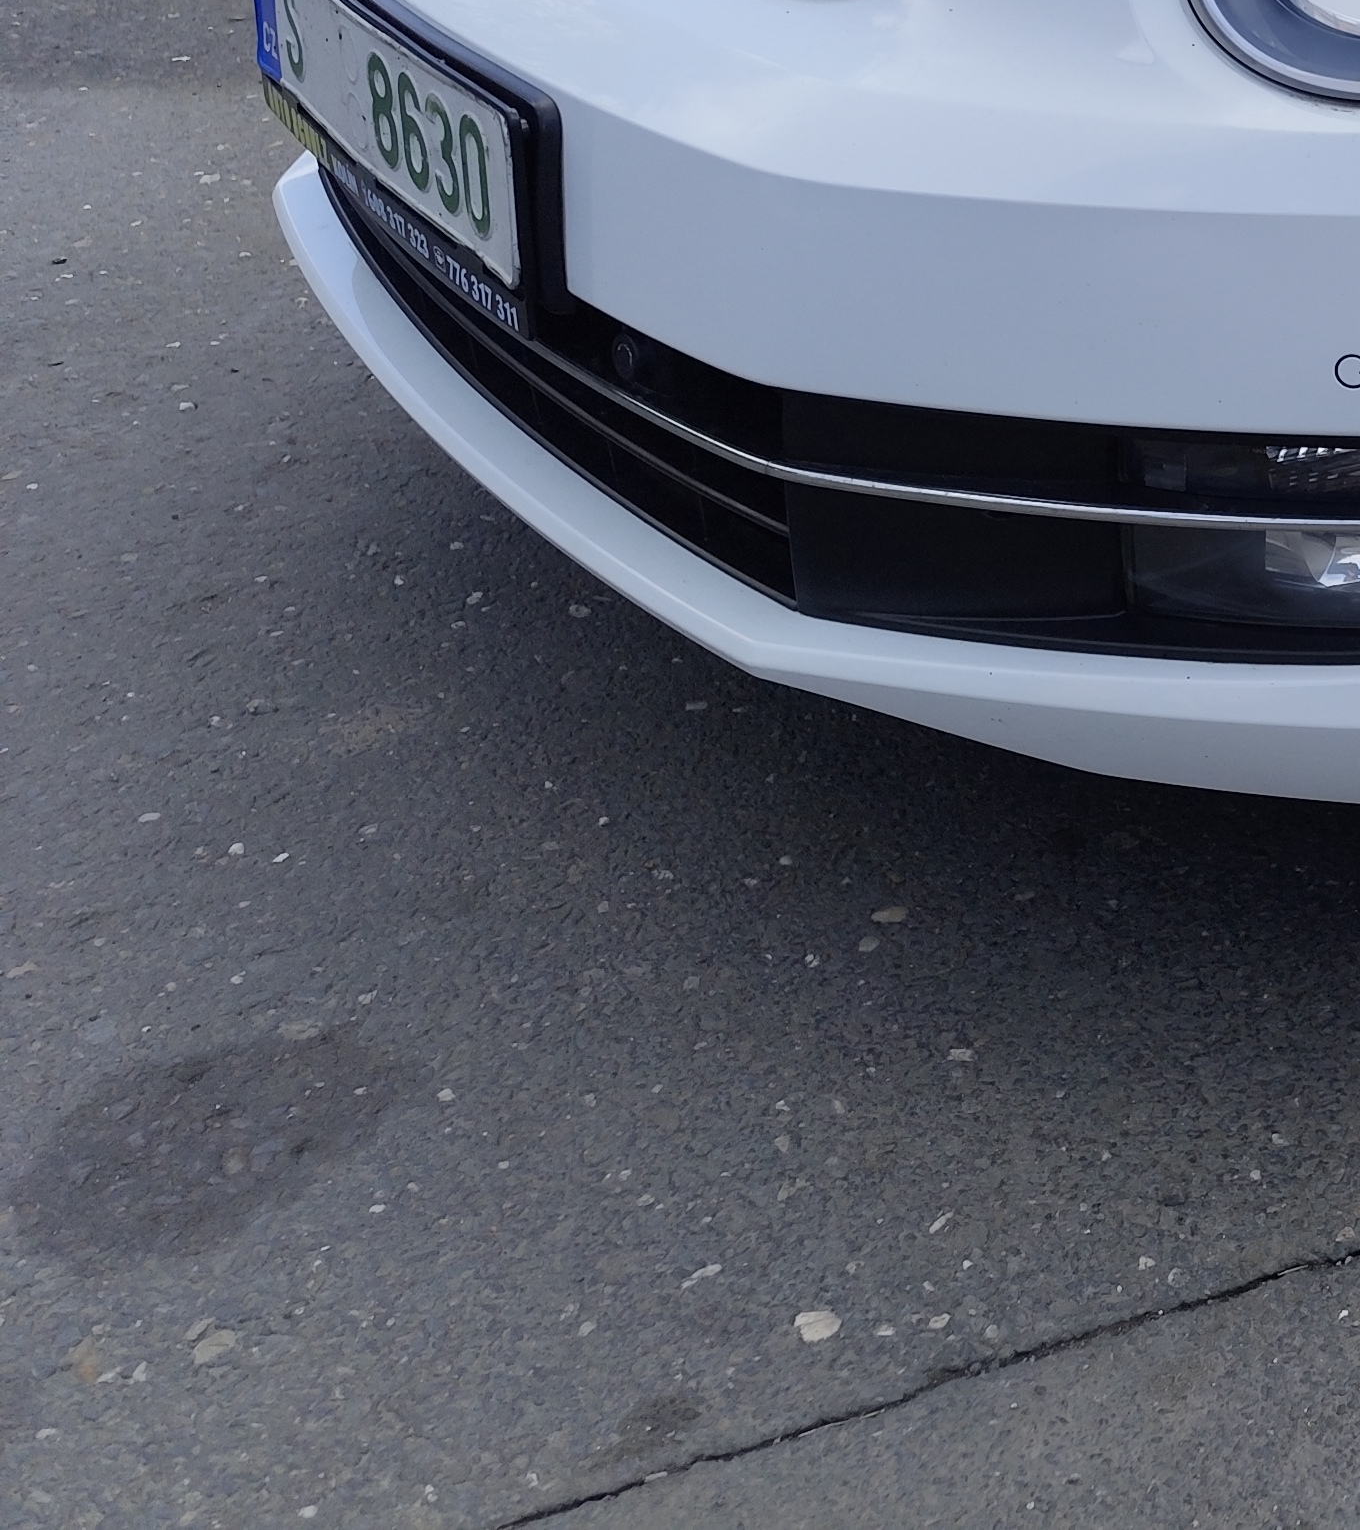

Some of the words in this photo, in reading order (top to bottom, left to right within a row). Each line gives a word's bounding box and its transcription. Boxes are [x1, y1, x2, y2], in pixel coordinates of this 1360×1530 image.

[263, 21, 279, 61] CZ
[367, 51, 491, 239] 8630
[408, 222, 430, 259] 323
[446, 255, 469, 293] 776
[471, 275, 492, 311] 317
[496, 294, 520, 332] 311
